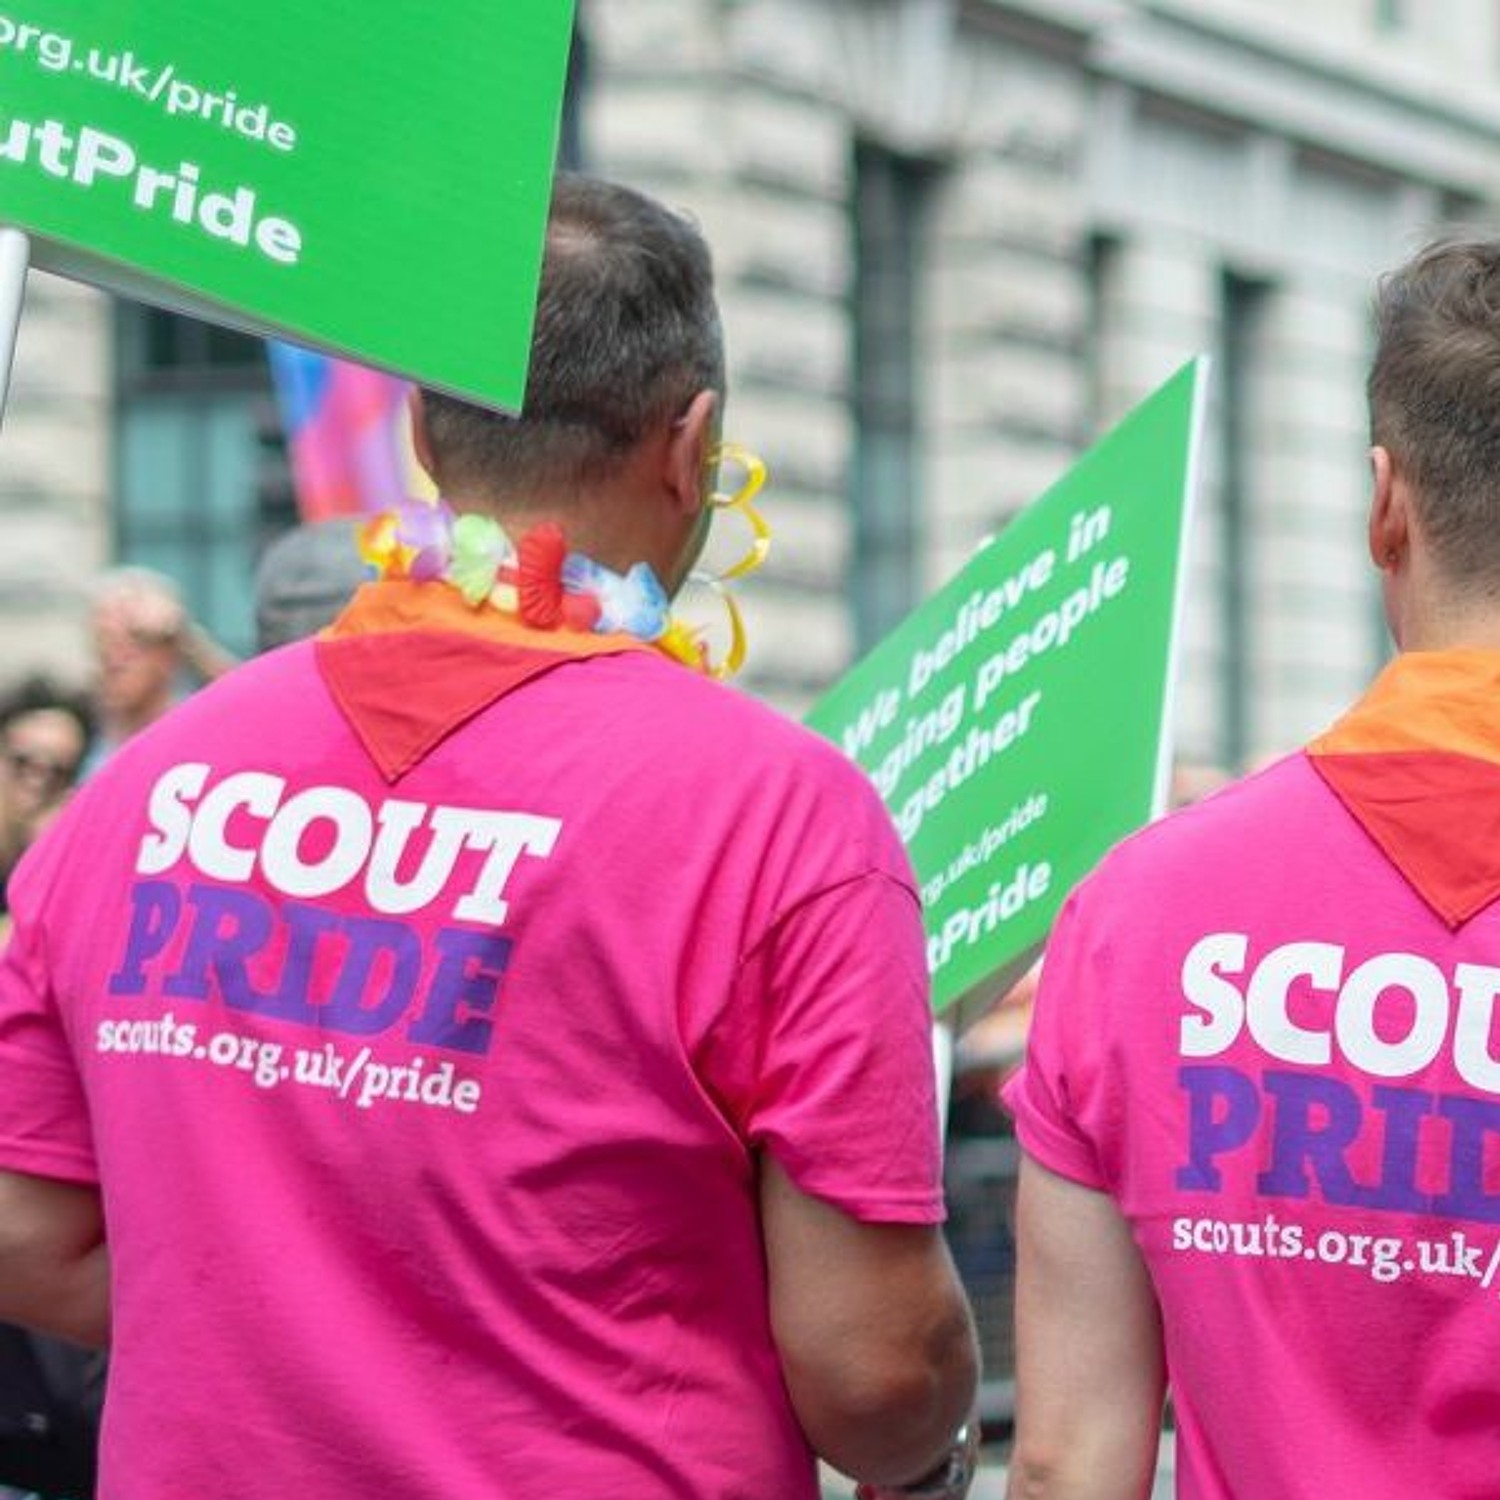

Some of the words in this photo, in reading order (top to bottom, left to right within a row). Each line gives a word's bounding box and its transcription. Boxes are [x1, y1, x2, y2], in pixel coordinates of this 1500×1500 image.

[843, 689, 900, 759] We
[910, 548, 1055, 698] believe
[1067, 505, 1112, 566] in
[974, 554, 1130, 711] people
[136, 763, 563, 925] SCOUT
[893, 688, 1042, 843] gether
[107, 880, 515, 1057] PRIDE
[97, 1012, 481, 1113] scouts.org.uk/pride
